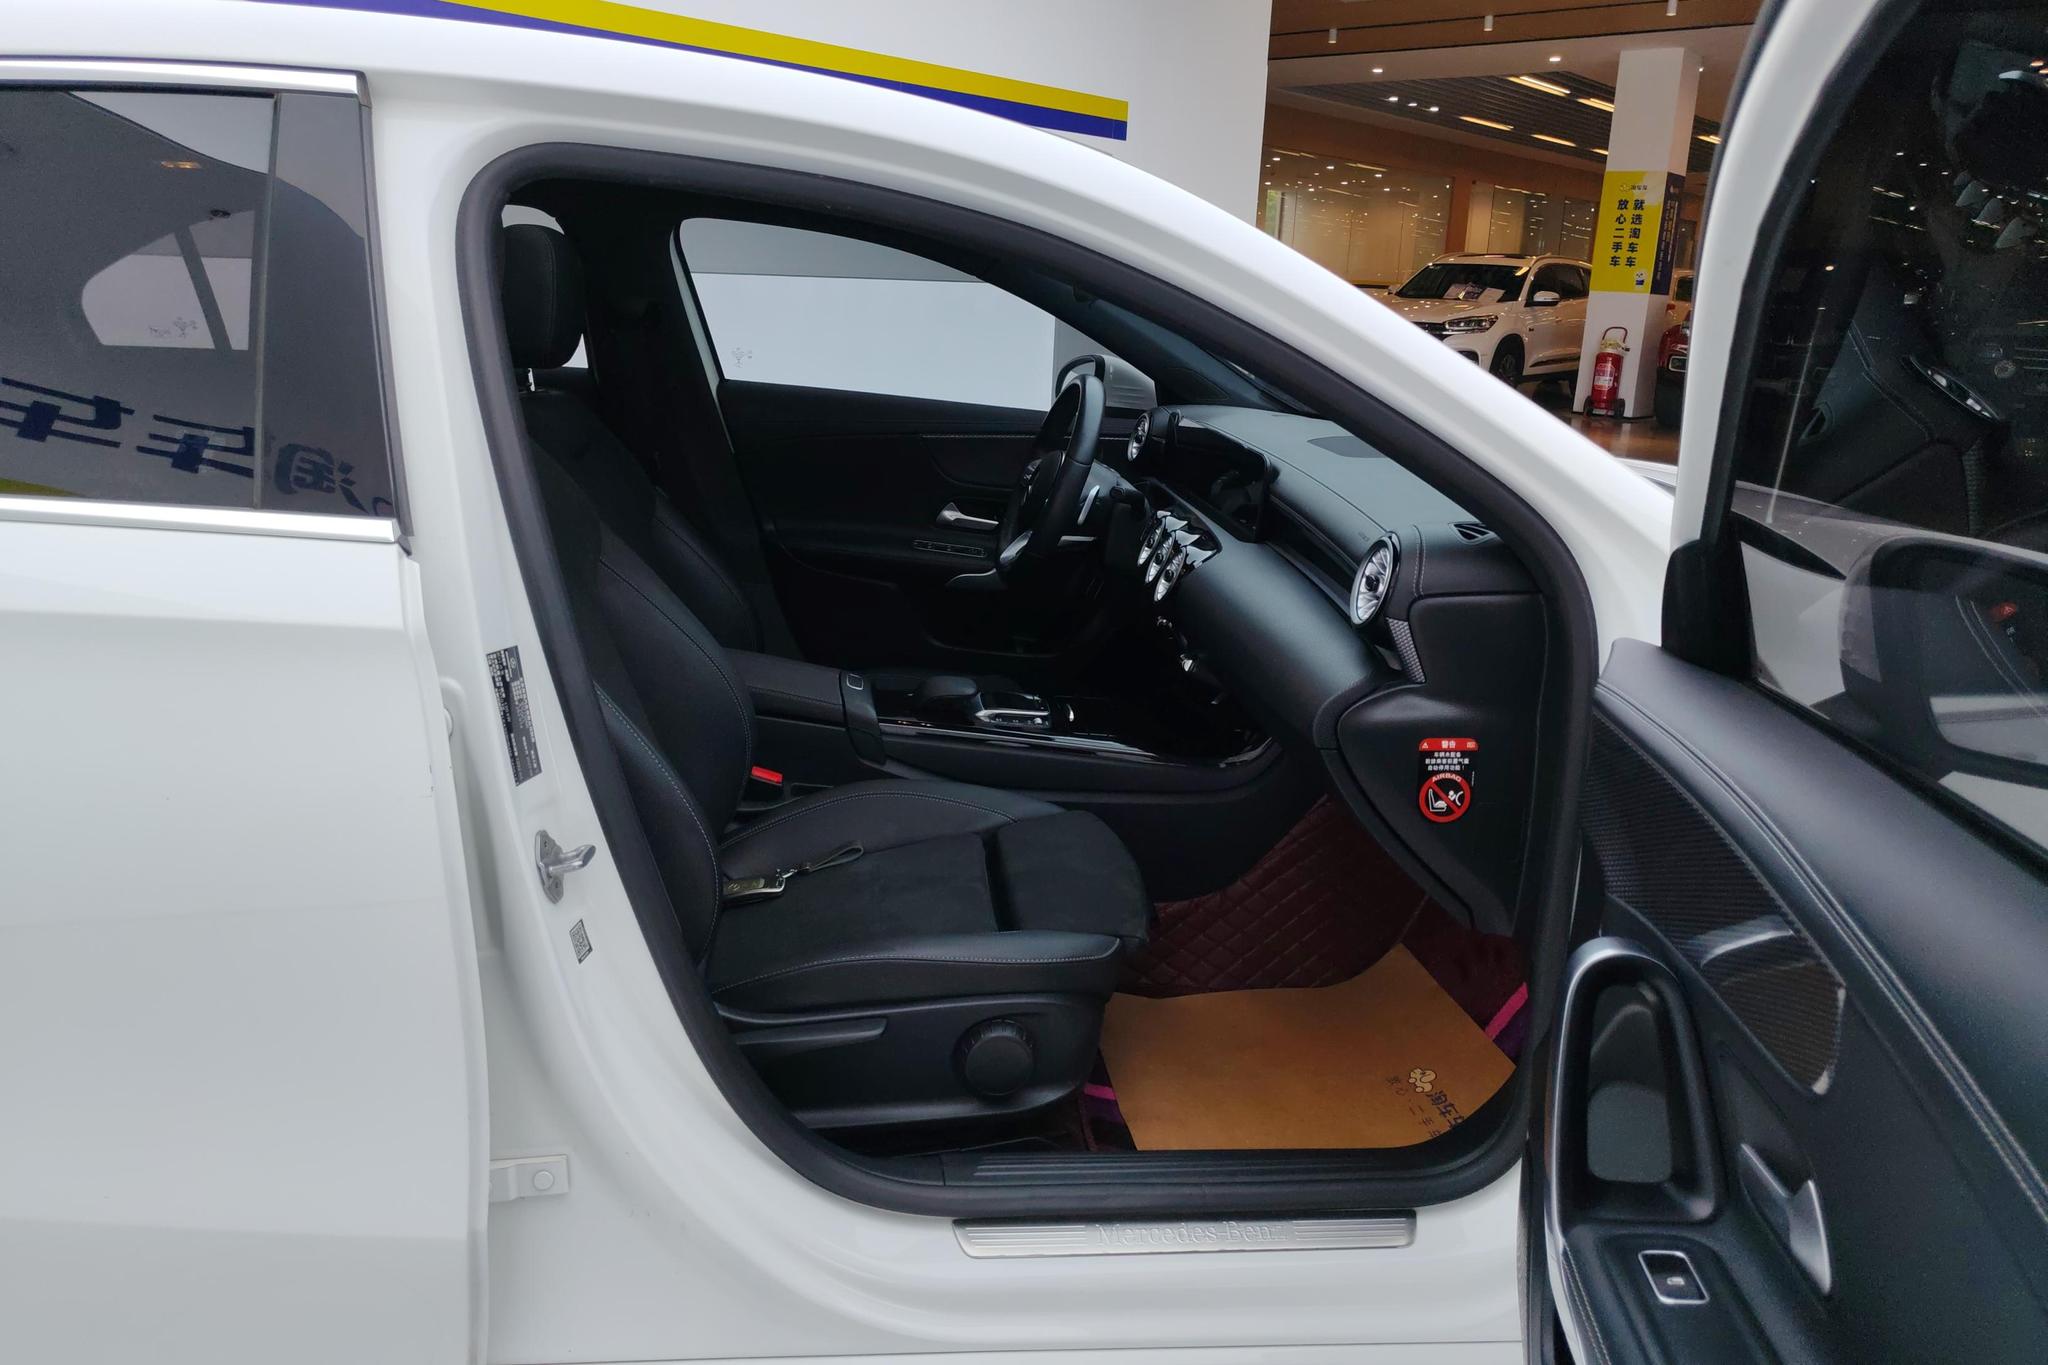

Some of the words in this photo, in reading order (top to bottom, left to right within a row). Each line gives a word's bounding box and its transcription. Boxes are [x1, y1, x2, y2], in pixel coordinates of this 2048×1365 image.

[1609, 199, 1629, 267] 放心二手车
[1625, 199, 1645, 268] 就选淘车车
[1441, 740, 1456, 748] 警告
[1432, 773, 1462, 782] AIRBAG
